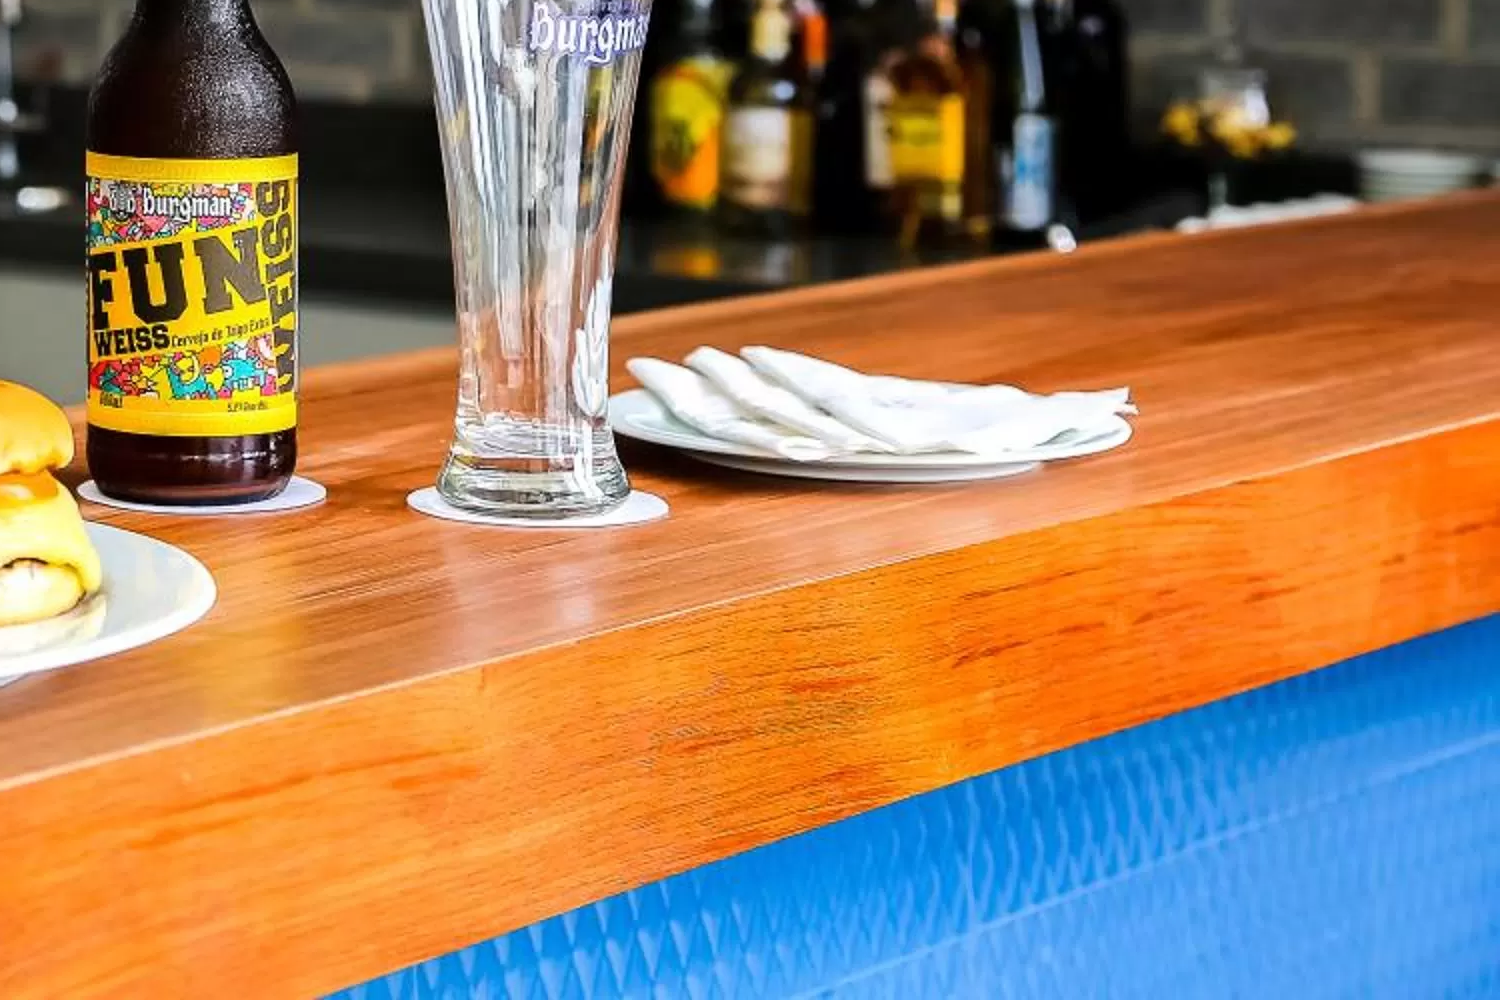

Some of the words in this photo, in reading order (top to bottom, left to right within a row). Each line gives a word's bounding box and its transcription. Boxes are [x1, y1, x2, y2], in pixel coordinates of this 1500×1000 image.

[90, 226, 269, 330] FUN
[256, 181, 294, 394] WEISS
[94, 325, 170, 357] WEISS
